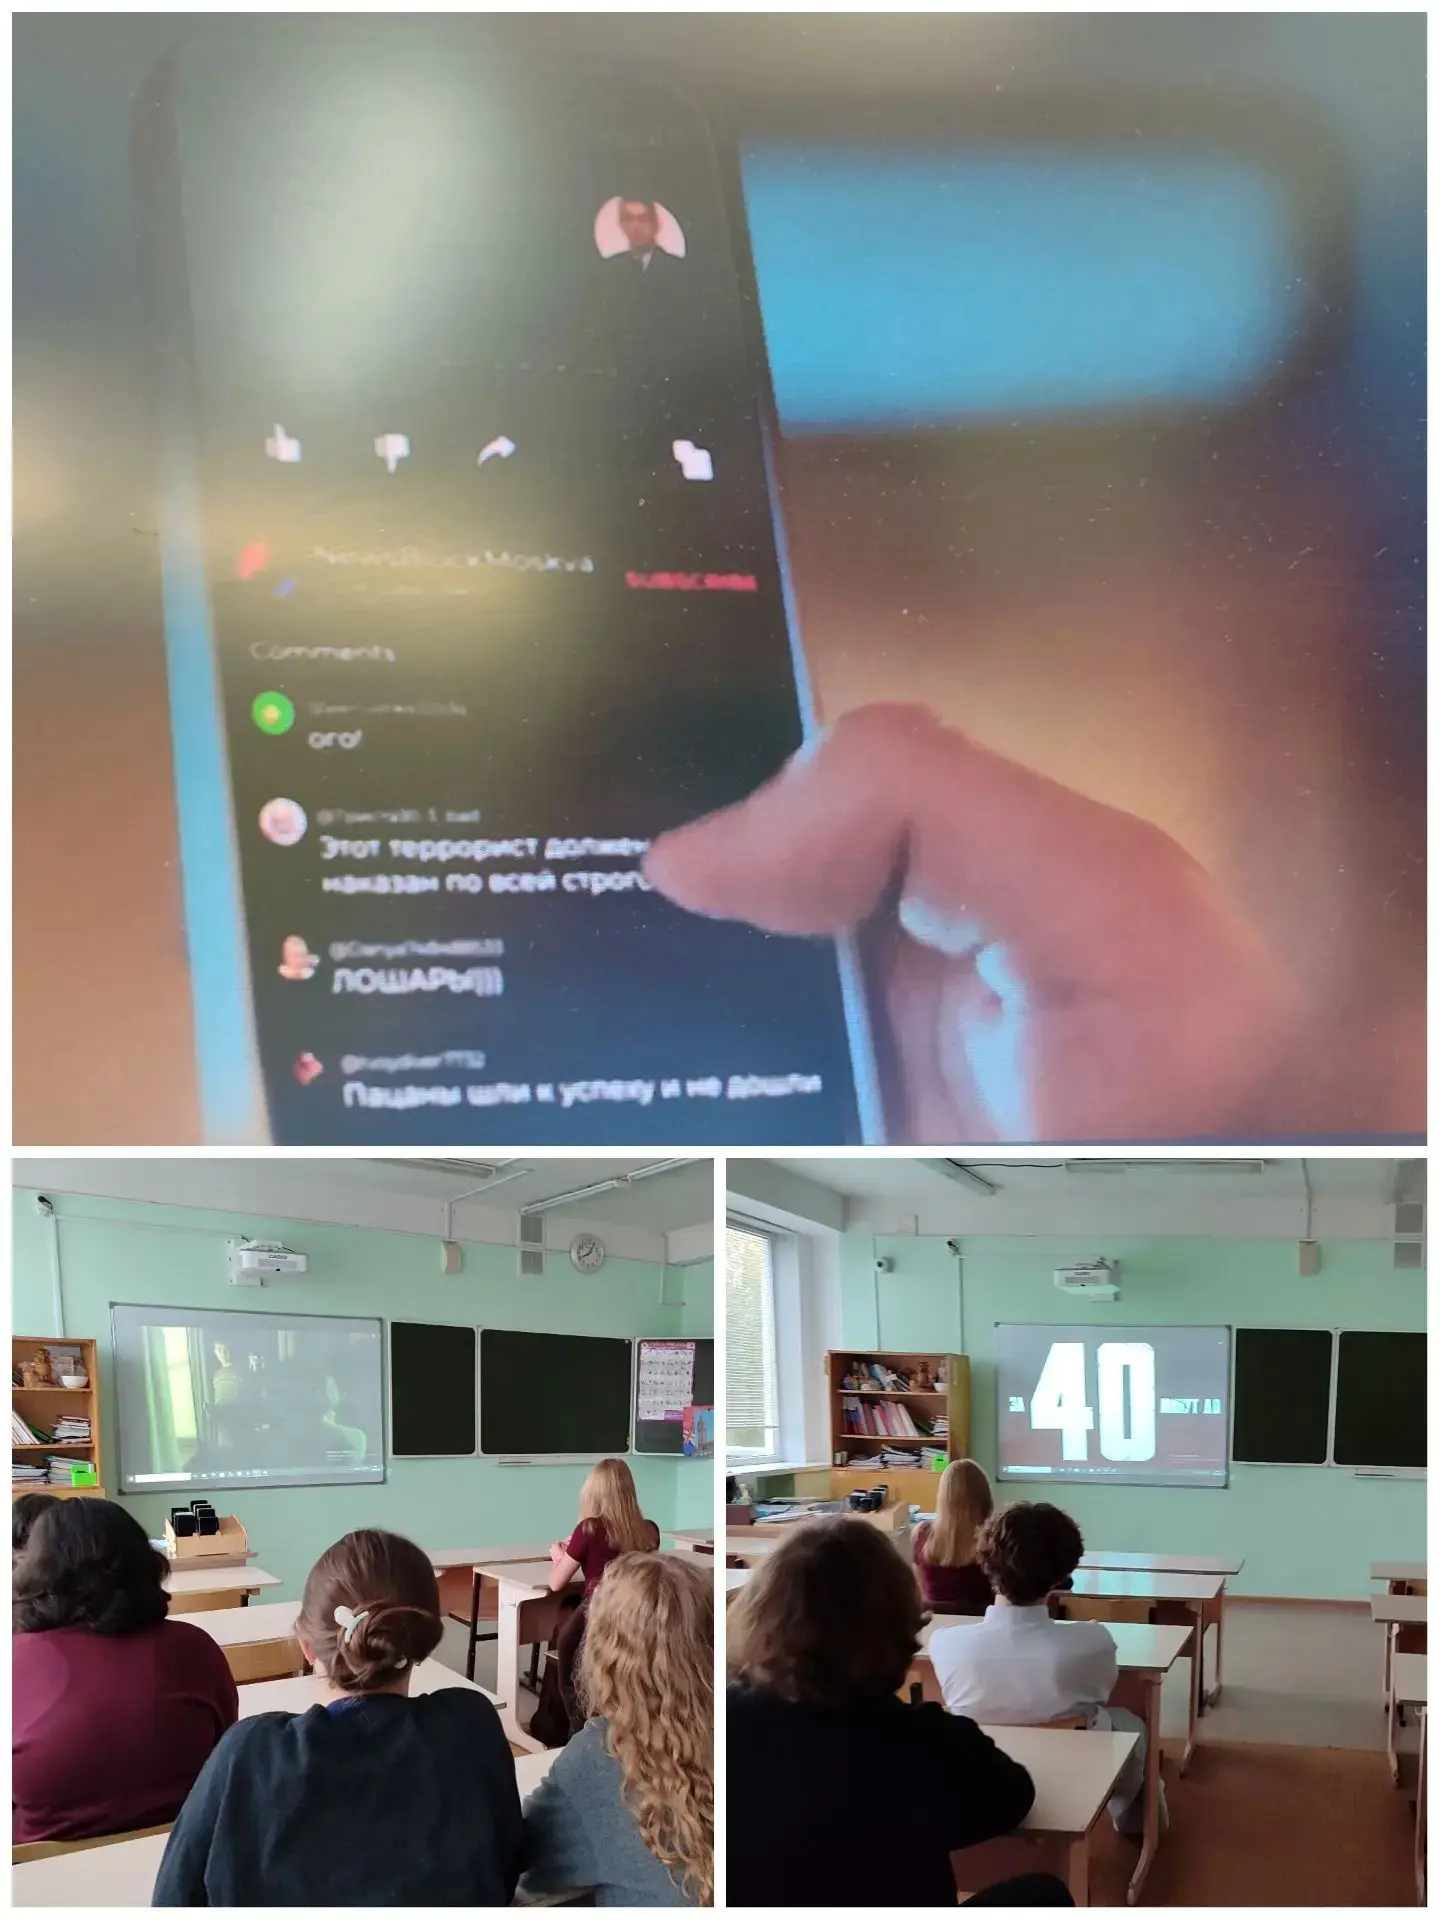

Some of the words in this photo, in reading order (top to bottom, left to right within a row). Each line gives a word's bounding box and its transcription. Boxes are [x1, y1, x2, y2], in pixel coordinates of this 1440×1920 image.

[319, 835, 381, 860] Этот
[388, 838, 538, 862] террорист
[322, 874, 440, 895] наказан
[445, 873, 483, 895] по
[488, 868, 557, 894] всей
[343, 1081, 461, 1110] Пацаны
[466, 1082, 531, 1107] шли
[536, 1083, 553, 1103] к
[559, 1079, 655, 1108] успеху
[660, 1079, 680, 1099] и
[686, 1077, 722, 1098] не
[727, 1074, 823, 1100] дошли
[1030, 1342, 1156, 1461] 40
